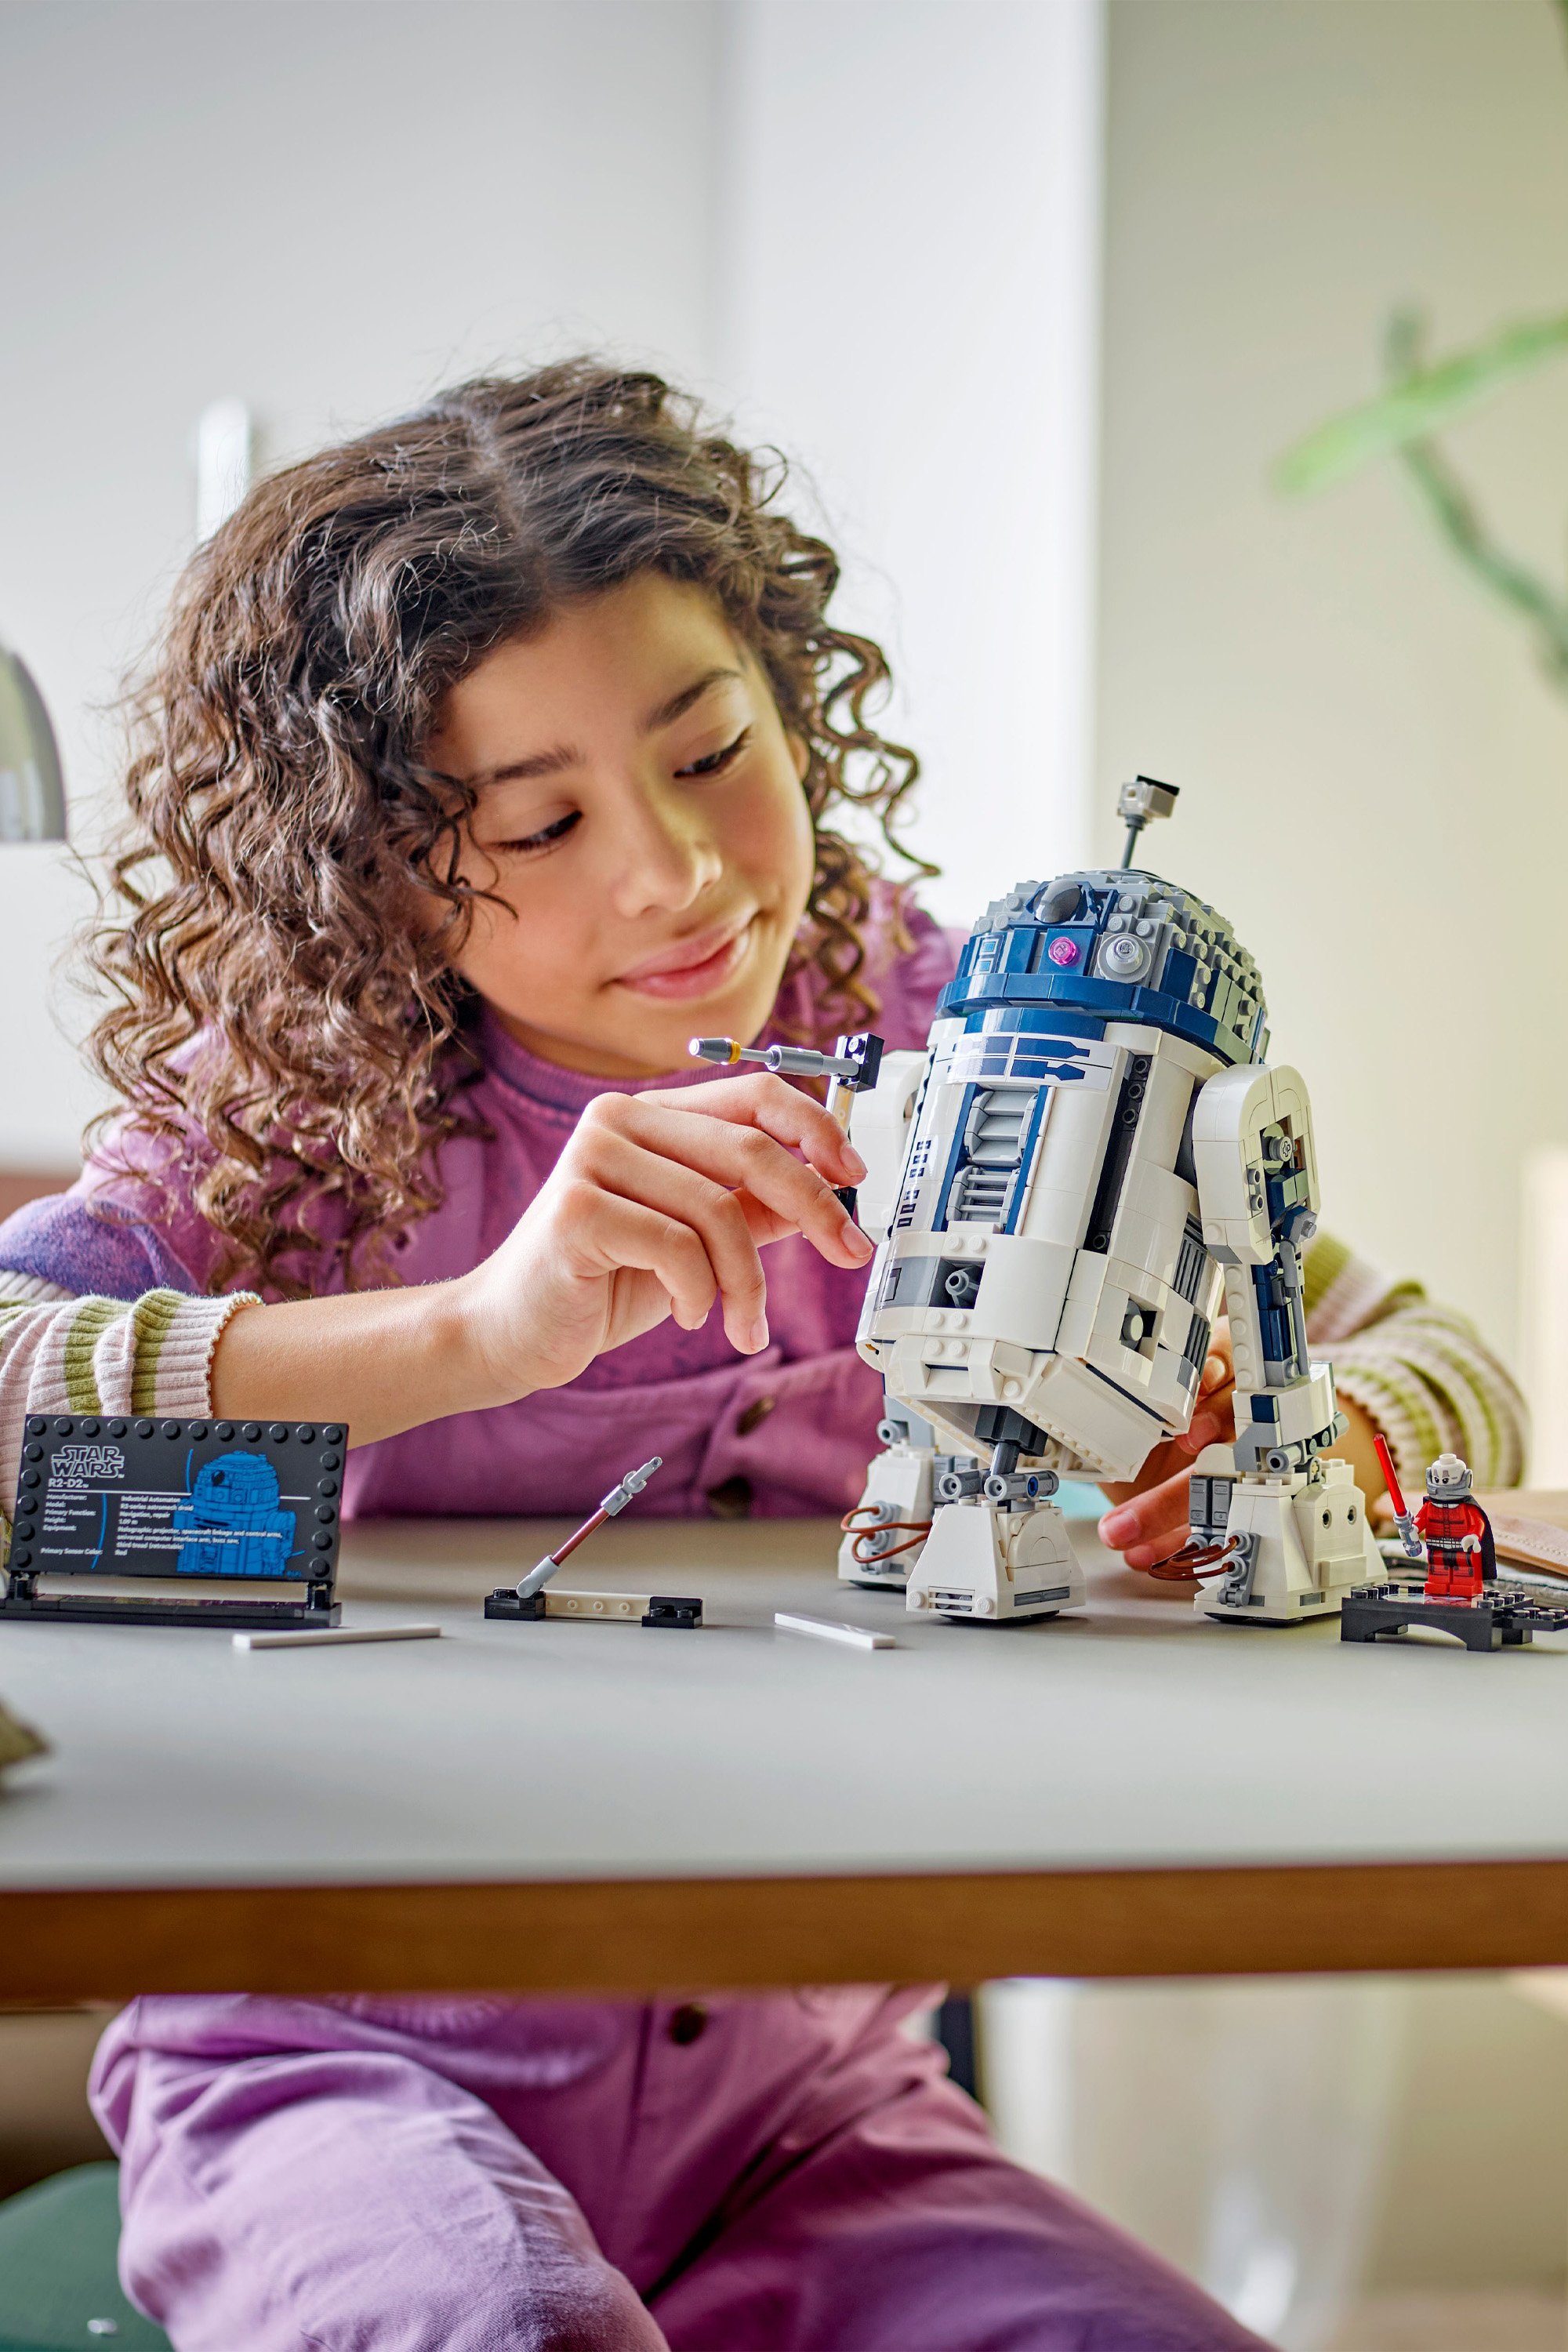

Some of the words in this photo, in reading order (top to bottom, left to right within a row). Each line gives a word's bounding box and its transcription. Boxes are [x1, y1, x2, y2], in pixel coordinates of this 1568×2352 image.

[51, 1445, 125, 1463] STAR
[51, 1461, 124, 1479] WARS
[48, 1478, 84, 1488] R2-D2
